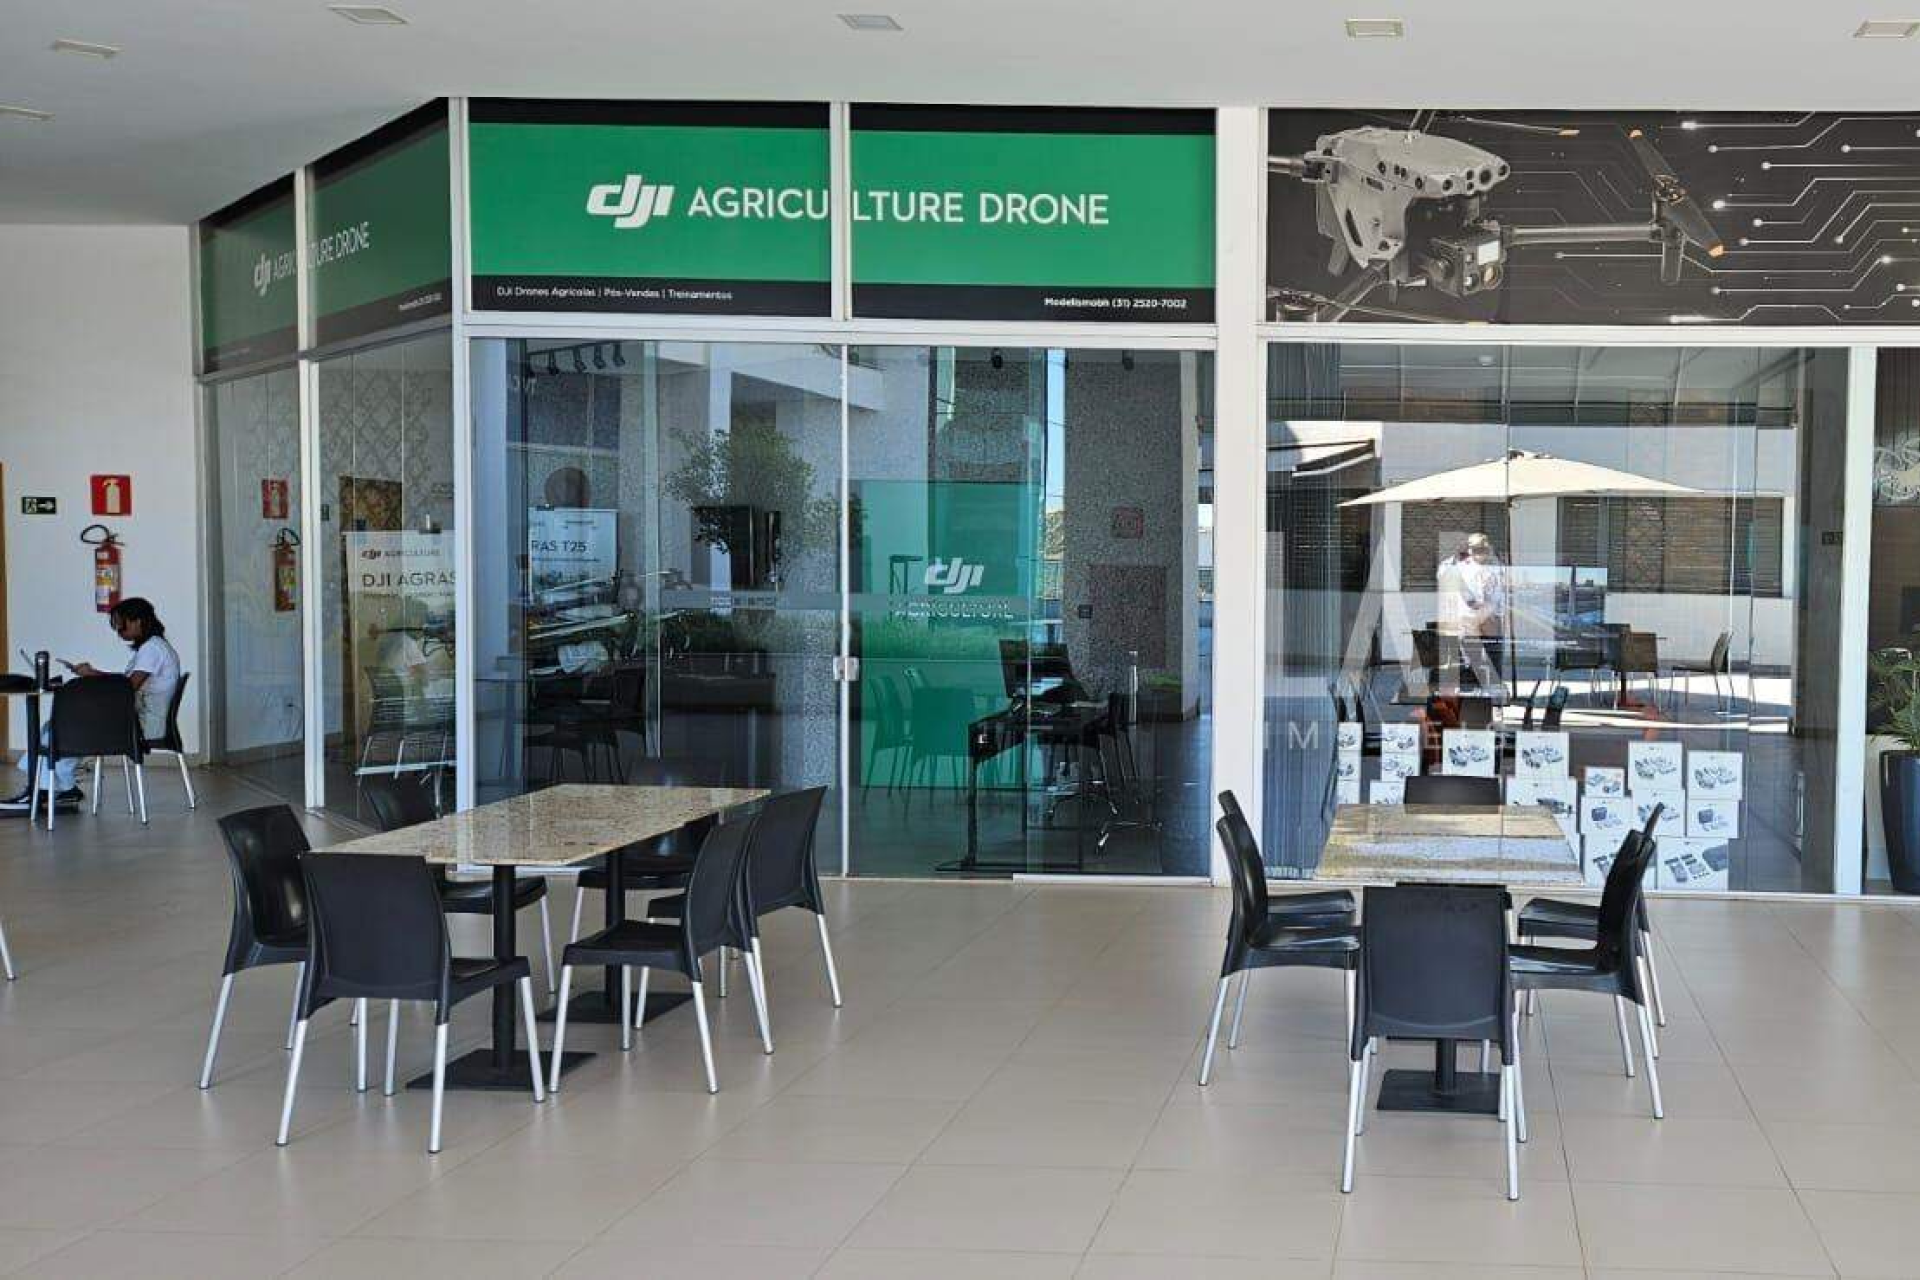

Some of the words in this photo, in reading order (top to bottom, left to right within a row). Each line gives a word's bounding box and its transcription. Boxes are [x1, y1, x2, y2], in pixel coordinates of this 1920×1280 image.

[687, 188, 964, 221] AGRICULTURE
[979, 193, 1110, 225] DRONE
[273, 236, 334, 281] AGRITURE
[335, 221, 370, 259] DRONE
[496, 286, 513, 297] DJI
[515, 286, 550, 298] Drones
[362, 573, 391, 587] DJI
